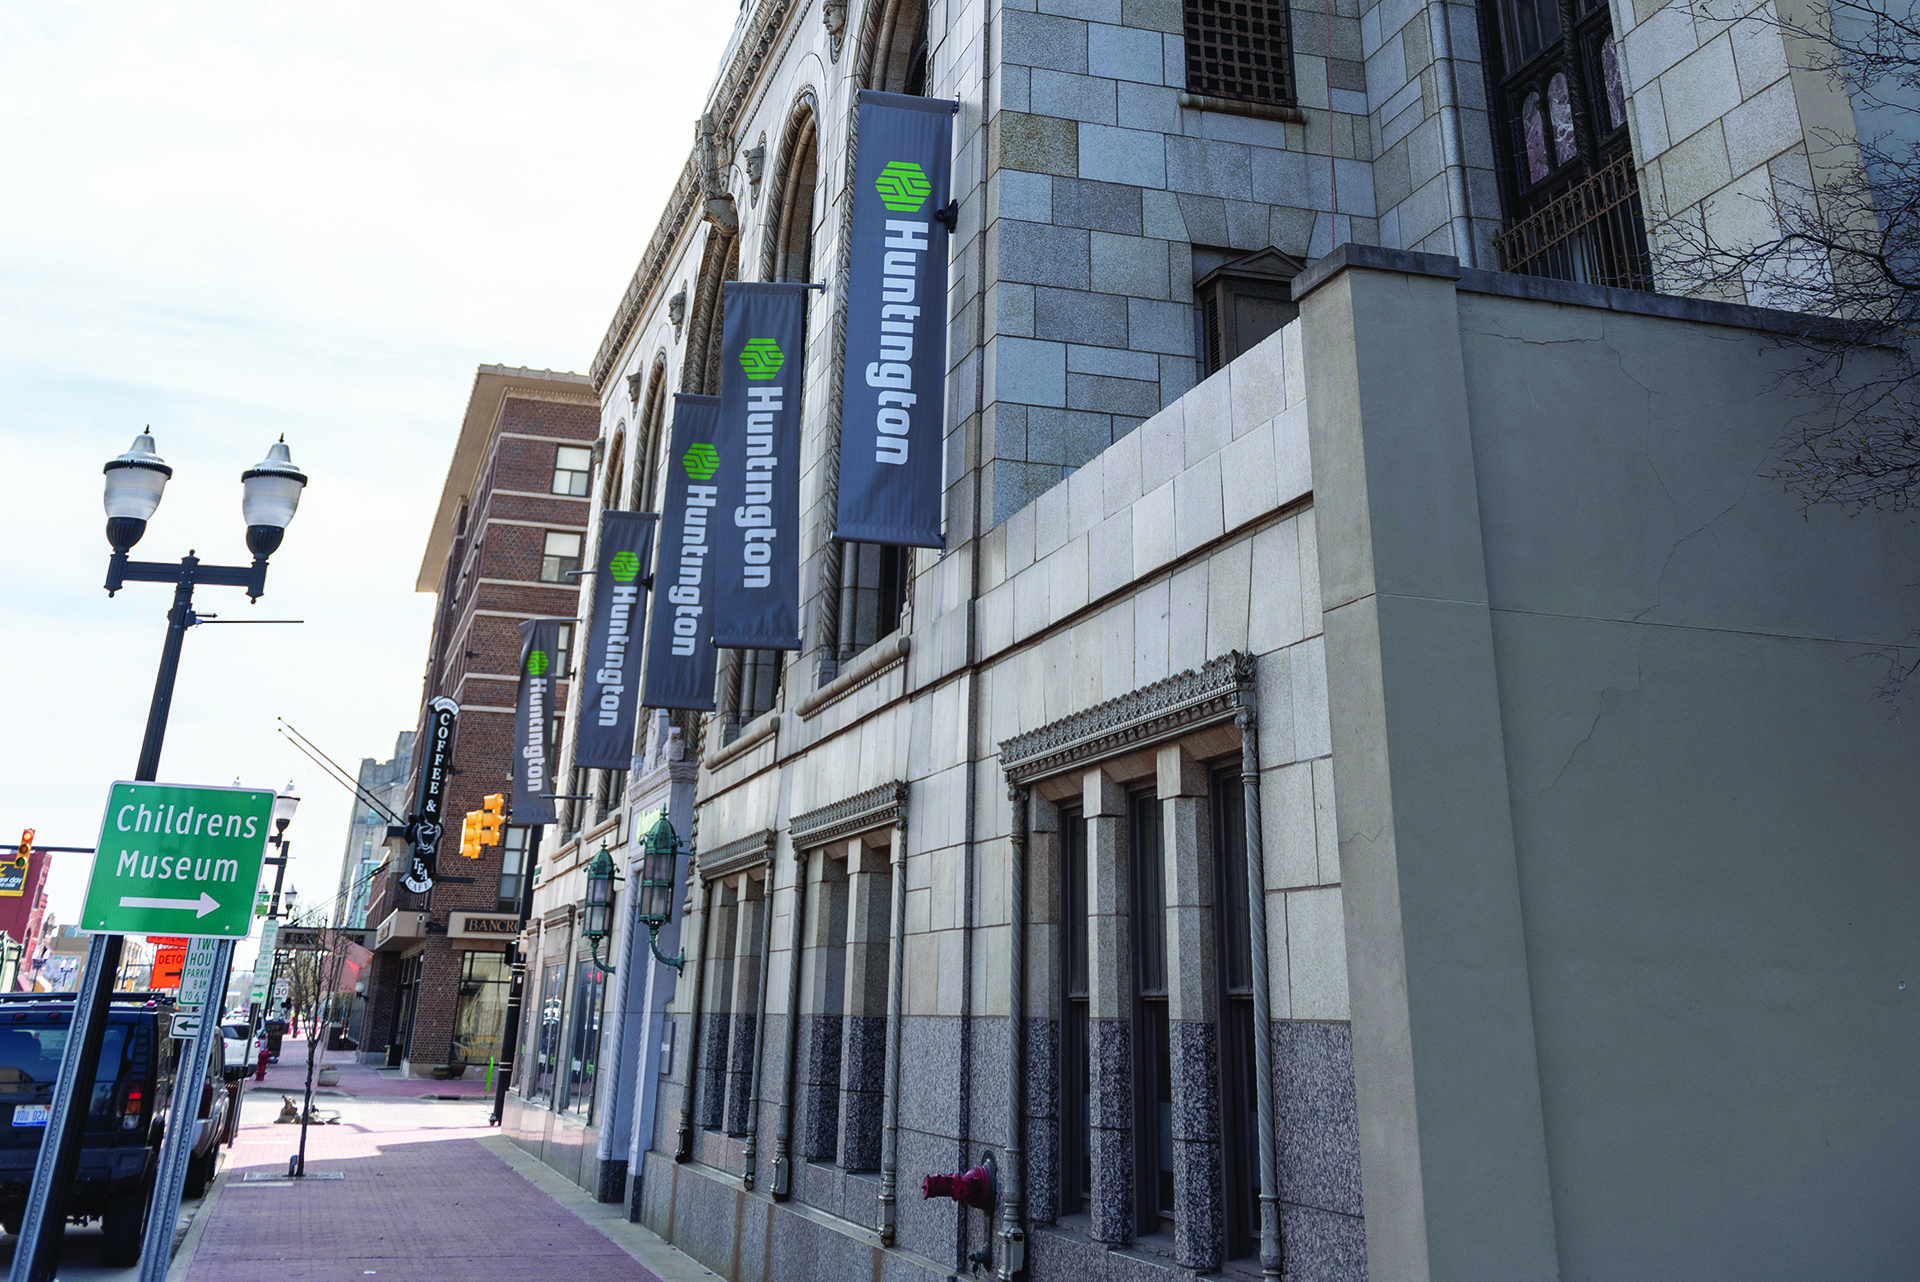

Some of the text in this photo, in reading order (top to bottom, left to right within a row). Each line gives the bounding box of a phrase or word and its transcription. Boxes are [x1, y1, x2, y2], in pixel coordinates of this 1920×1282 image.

[865, 219, 929, 466] Huntington
[734, 386, 783, 588] Huntington
[668, 484, 717, 657] Huntington
[596, 586, 638, 727] Huntington
[522, 678, 548, 792] Huntington
[429, 713, 450, 795] COFFEE
[426, 799, 437, 813] &
[117, 803, 258, 838] Childrens
[116, 850, 238, 882] Museum
[413, 857, 428, 880] TEA
[469, 919, 519, 932] BANCR
[158, 954, 186, 964] DETO
[189, 952, 213, 966] HOU
[186, 968, 210, 978] PARKIN
[185, 990, 193, 1000] TO
[275, 988, 287, 996] 30
